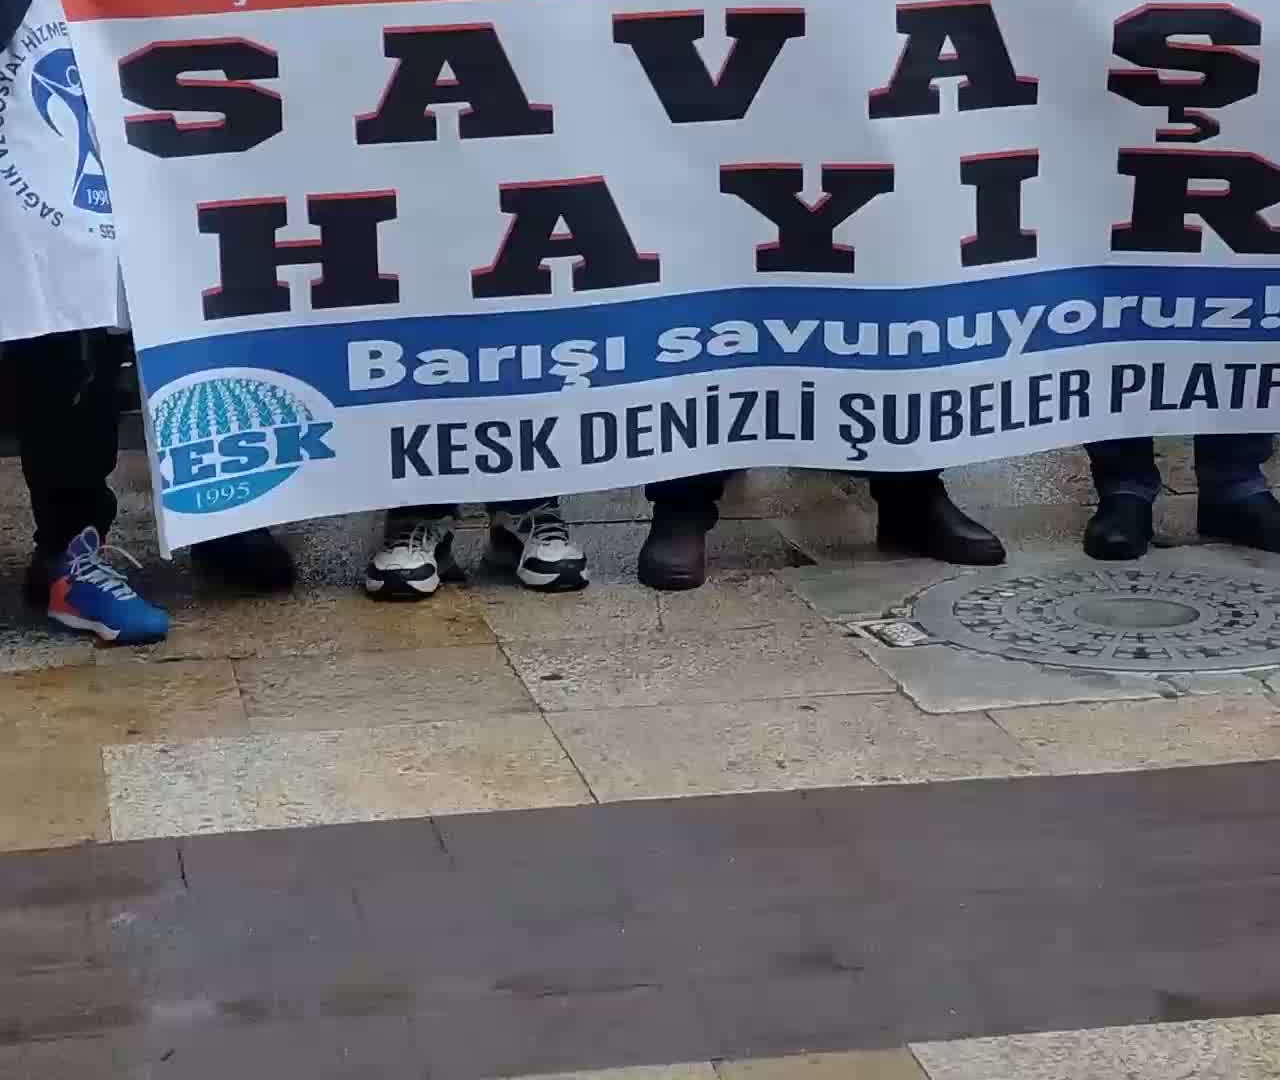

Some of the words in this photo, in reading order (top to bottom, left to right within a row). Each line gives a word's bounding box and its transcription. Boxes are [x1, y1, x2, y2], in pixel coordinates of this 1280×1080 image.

[20, 21, 69, 53] HİZME
[0, 164, 64, 227] SAĞLIK
[346, 334, 627, 392] Barışı
[390, 414, 563, 480] KESK
[579, 380, 816, 465] DENİZLİ
[838, 368, 1092, 462] ŞUBELER
[194, 481, 251, 509] 1995
